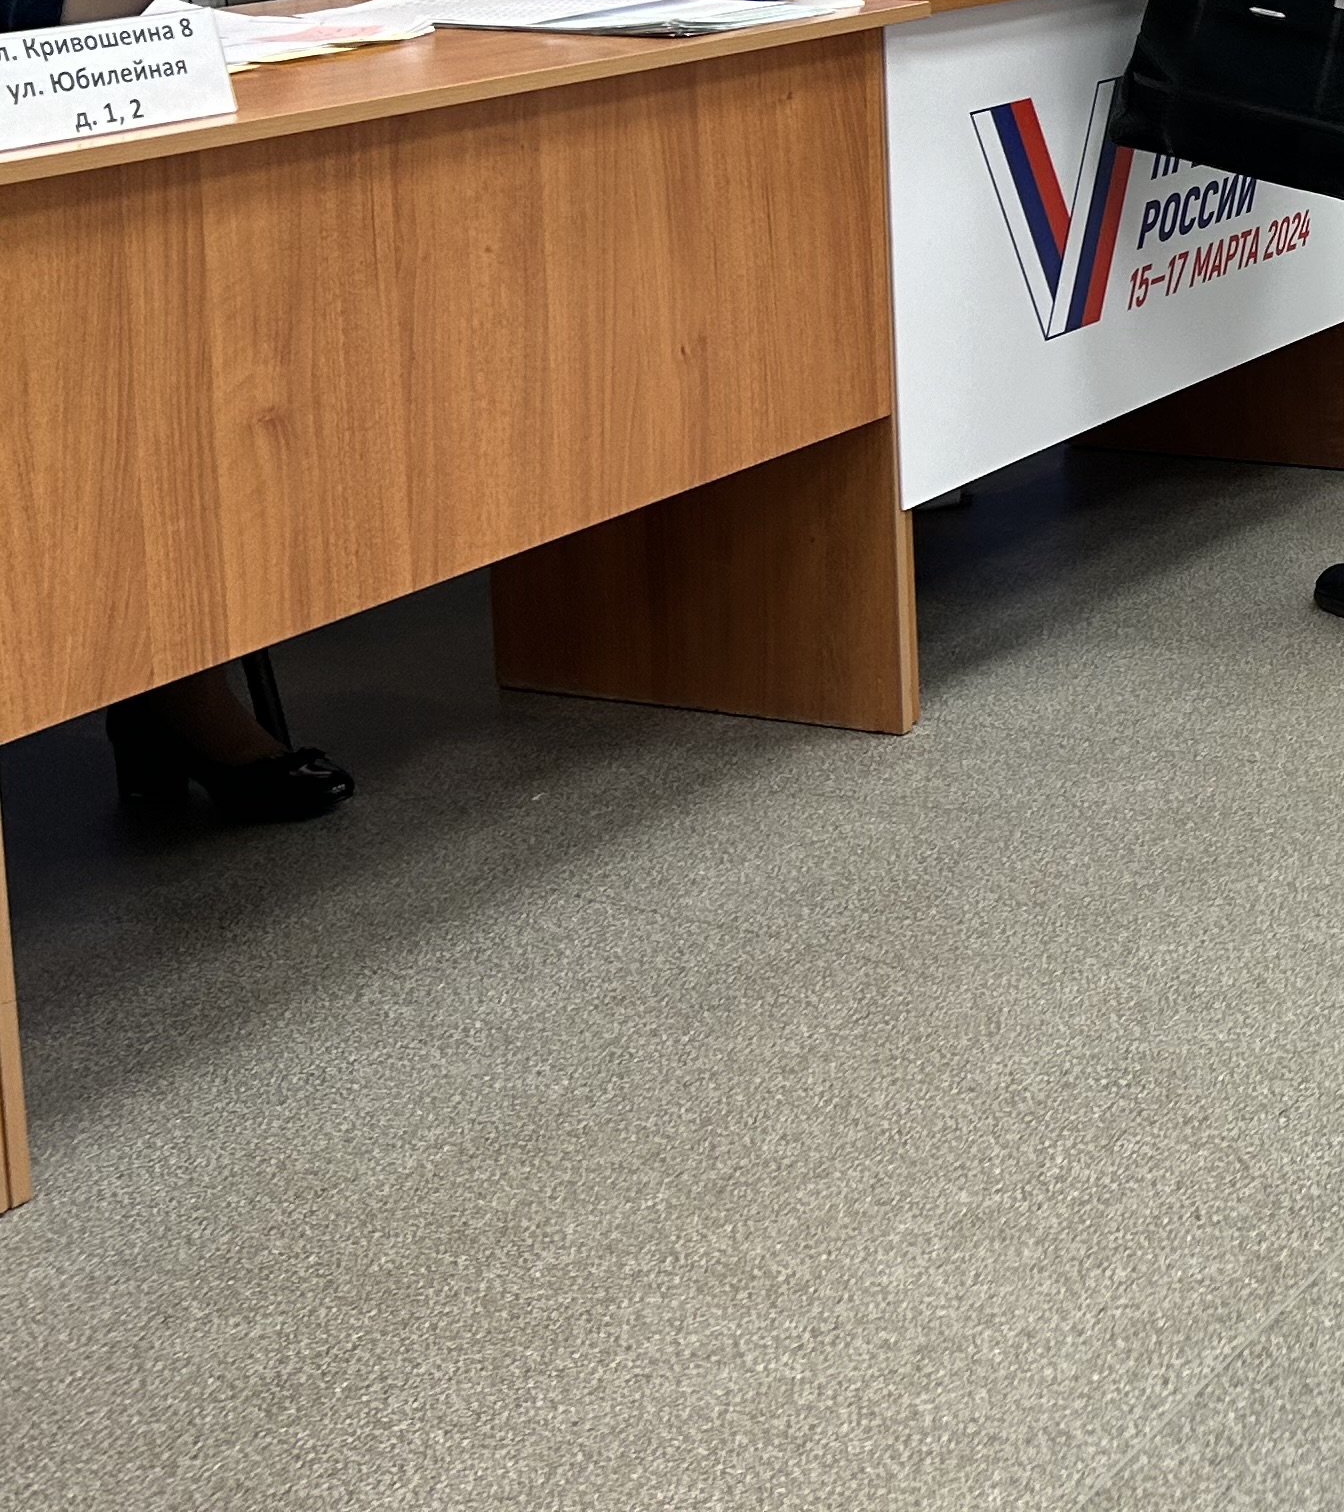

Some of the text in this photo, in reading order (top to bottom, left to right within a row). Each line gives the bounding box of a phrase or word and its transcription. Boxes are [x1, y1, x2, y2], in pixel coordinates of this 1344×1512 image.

[22, 24, 175, 62] Кривошеина
[179, 17, 194, 38] 8
[6, 58, 188, 105] ул. Юбилейная
[75, 98, 145, 132] д. 1, 2
[1137, 174, 1258, 250] РОССИИ
[1188, 225, 1260, 289] МАРТА
[1262, 208, 1312, 262] 2024
